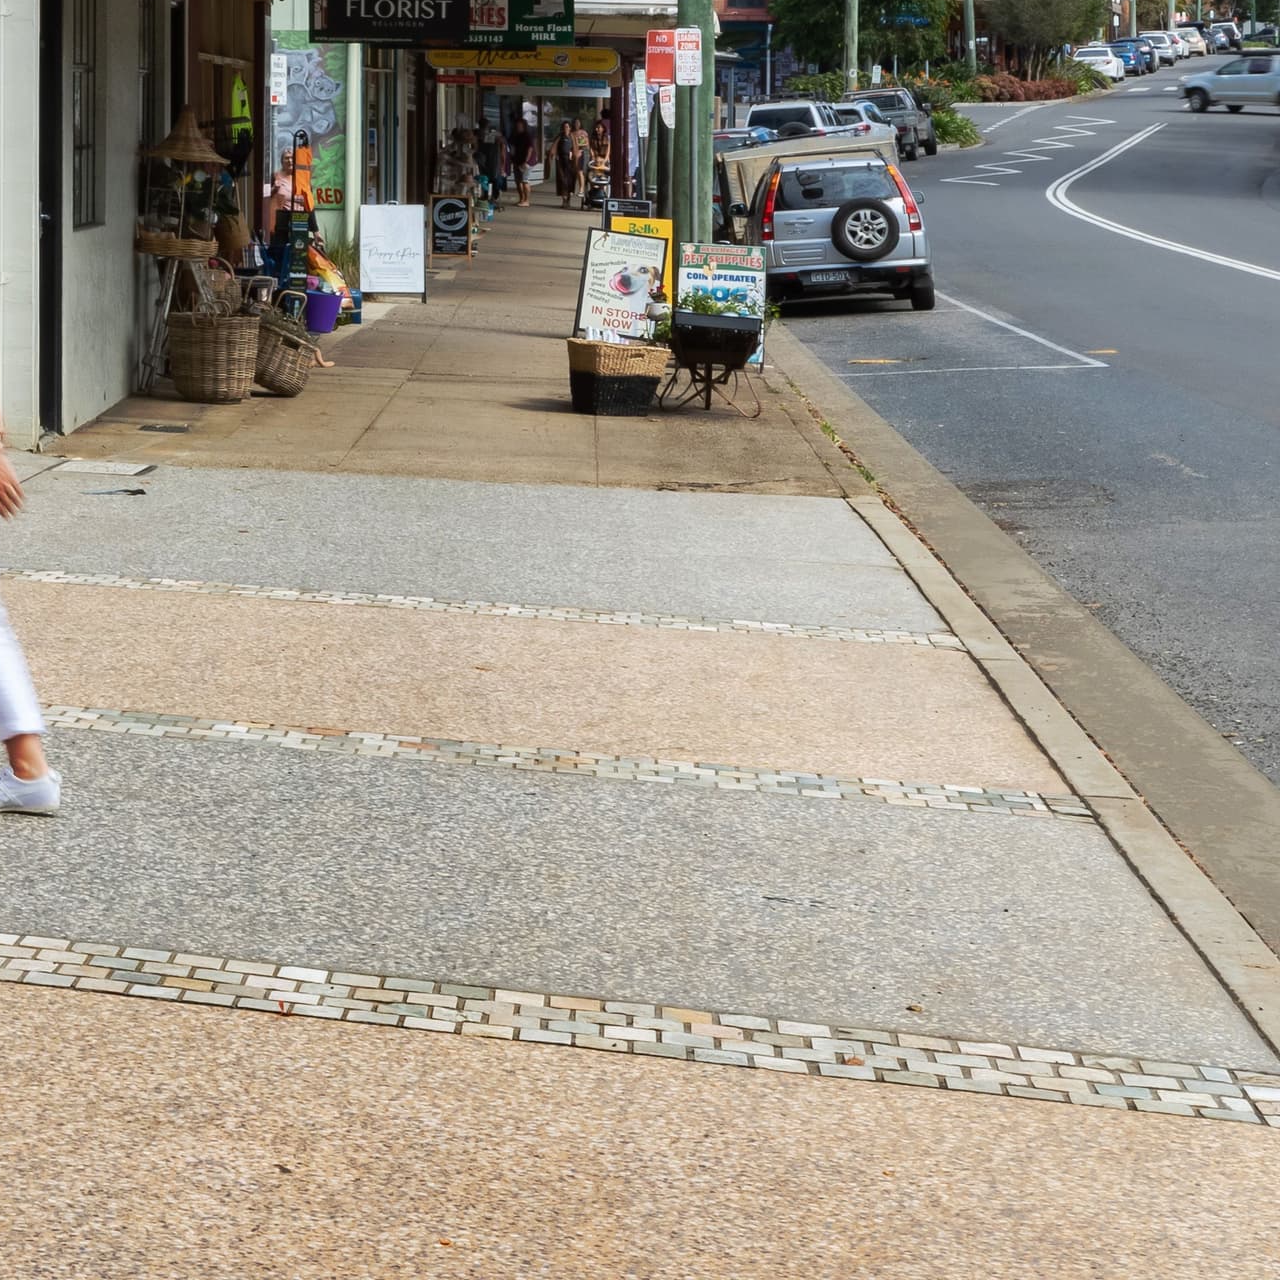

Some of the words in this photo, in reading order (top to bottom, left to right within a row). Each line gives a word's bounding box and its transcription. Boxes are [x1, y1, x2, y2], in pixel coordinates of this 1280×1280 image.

[515, 24, 544, 32] Horse
[546, 23, 573, 32] Float
[531, 32, 557, 41] HIRE
[655, 35, 668, 43] NO
[648, 46, 674, 54] STOPPING
[680, 42, 697, 50] ZONE
[683, 253, 705, 265] PET
[708, 255, 762, 269] SUPPLIES
[686, 272, 708, 280] COIN
[711, 273, 757, 283] OPERATED
[591, 304, 603, 315] IN
[602, 317, 632, 330] NOW
